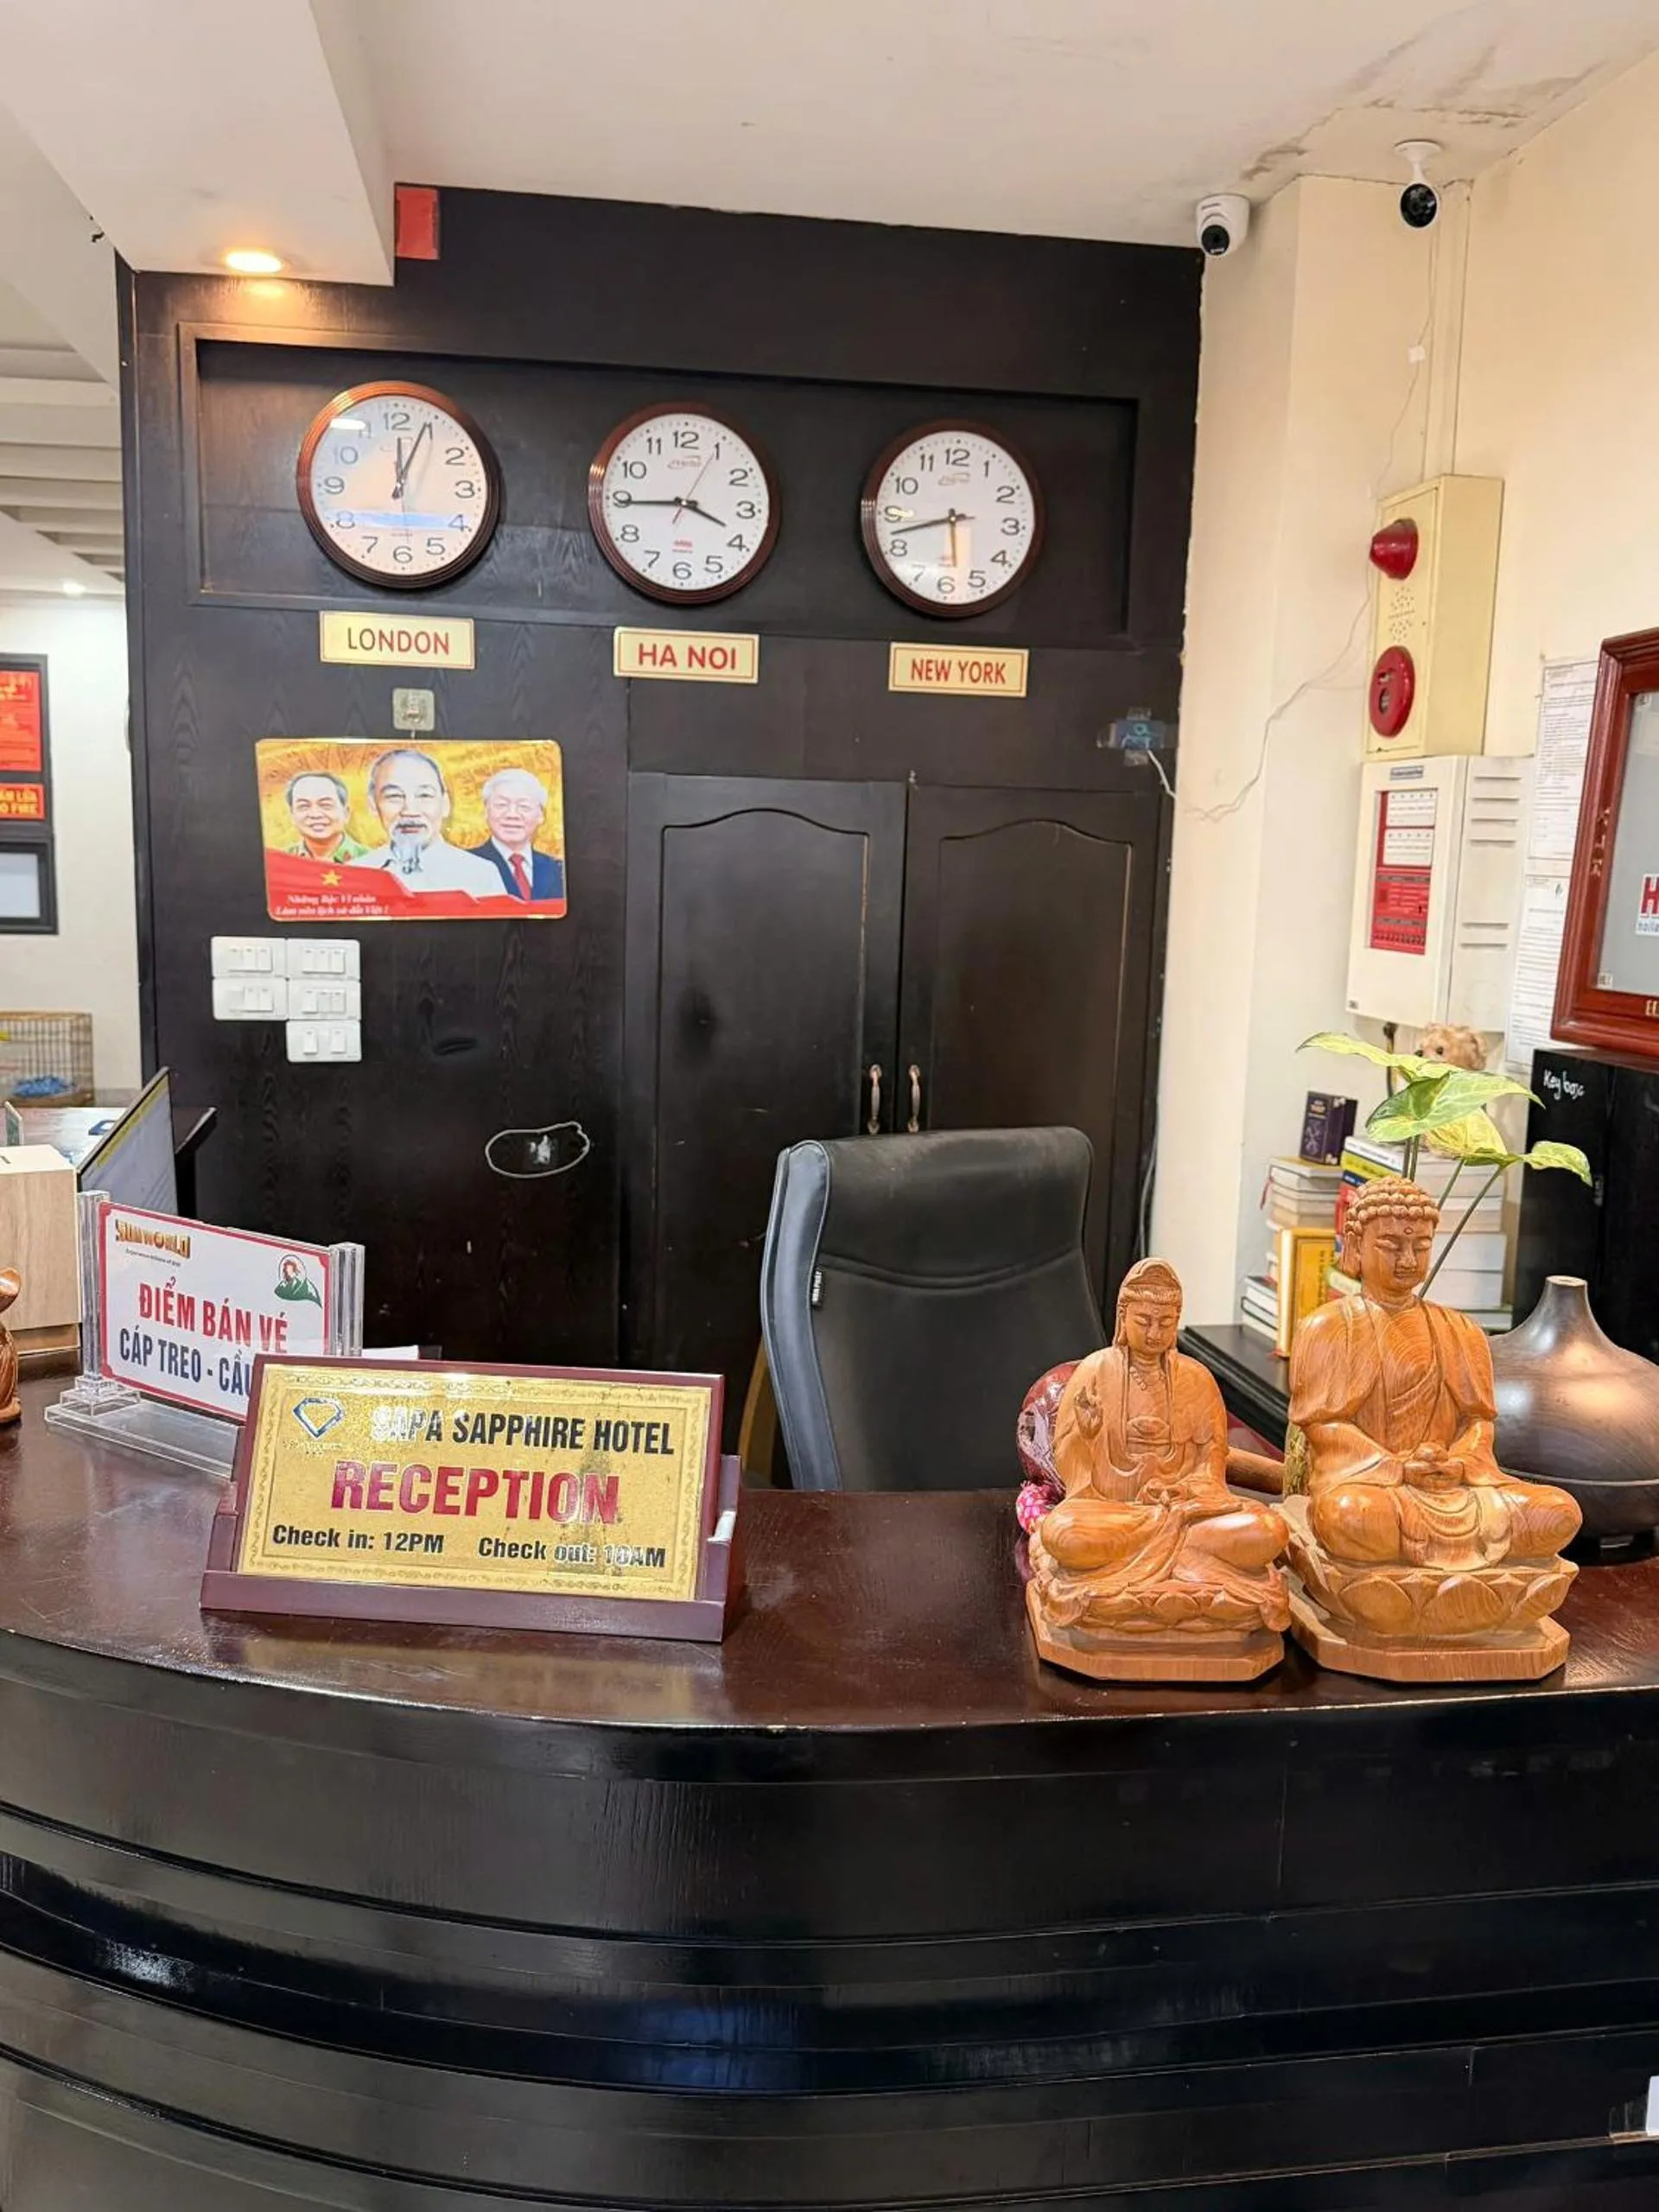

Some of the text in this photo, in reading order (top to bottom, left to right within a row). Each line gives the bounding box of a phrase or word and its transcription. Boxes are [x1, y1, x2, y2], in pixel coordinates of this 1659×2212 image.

[384, 411, 411, 431] 12
[647, 437, 662, 455] 11
[673, 430, 699, 449] 12
[334, 446, 359, 464] 10
[445, 448, 466, 466] 2
[714, 442, 721, 461] 1
[945, 448, 969, 467] 12
[622, 461, 647, 480] 10
[919, 454, 934, 472] 11
[983, 460, 989, 478] 1
[323, 476, 344, 494] 9
[728, 468, 749, 486] 2
[895, 476, 918, 495] 10
[454, 480, 474, 499] 3
[995, 486, 1015, 504] 2
[613, 491, 632, 509] 9
[735, 501, 755, 519] 3
[884, 505, 903, 524] 9
[334, 511, 355, 530] 8
[448, 514, 468, 532] 4
[1001, 518, 1020, 537] 3
[620, 524, 639, 543] 8
[727, 534, 745, 552] 4
[361, 536, 378, 554] 7
[426, 537, 446, 556] 5
[889, 539, 907, 557] 8
[392, 546, 413, 564] 6
[645, 550, 661, 569] 7
[991, 550, 1009, 568] 4
[672, 562, 692, 580] 6
[703, 556, 723, 574] 5
[912, 564, 926, 582] 7
[937, 576, 955, 594] 6
[968, 570, 987, 588] 5
[347, 627, 449, 655] LONDON
[638, 643, 736, 671] HA NOI
[911, 658, 1006, 684] NEW YORK
[139, 1276, 288, 1353] ĐIỂM BÁN VÉ
[119, 1325, 153, 1367] CÁP
[158, 1340, 201, 1382] TREO
[452, 1409, 585, 1449] SAPPHIRE
[594, 1419, 674, 1454] HOTEL
[331, 1460, 620, 1524] RECEPTION
[273, 1524, 445, 1554] Check in: 12PM
[478, 1537, 666, 1568] Check out: 10AM
